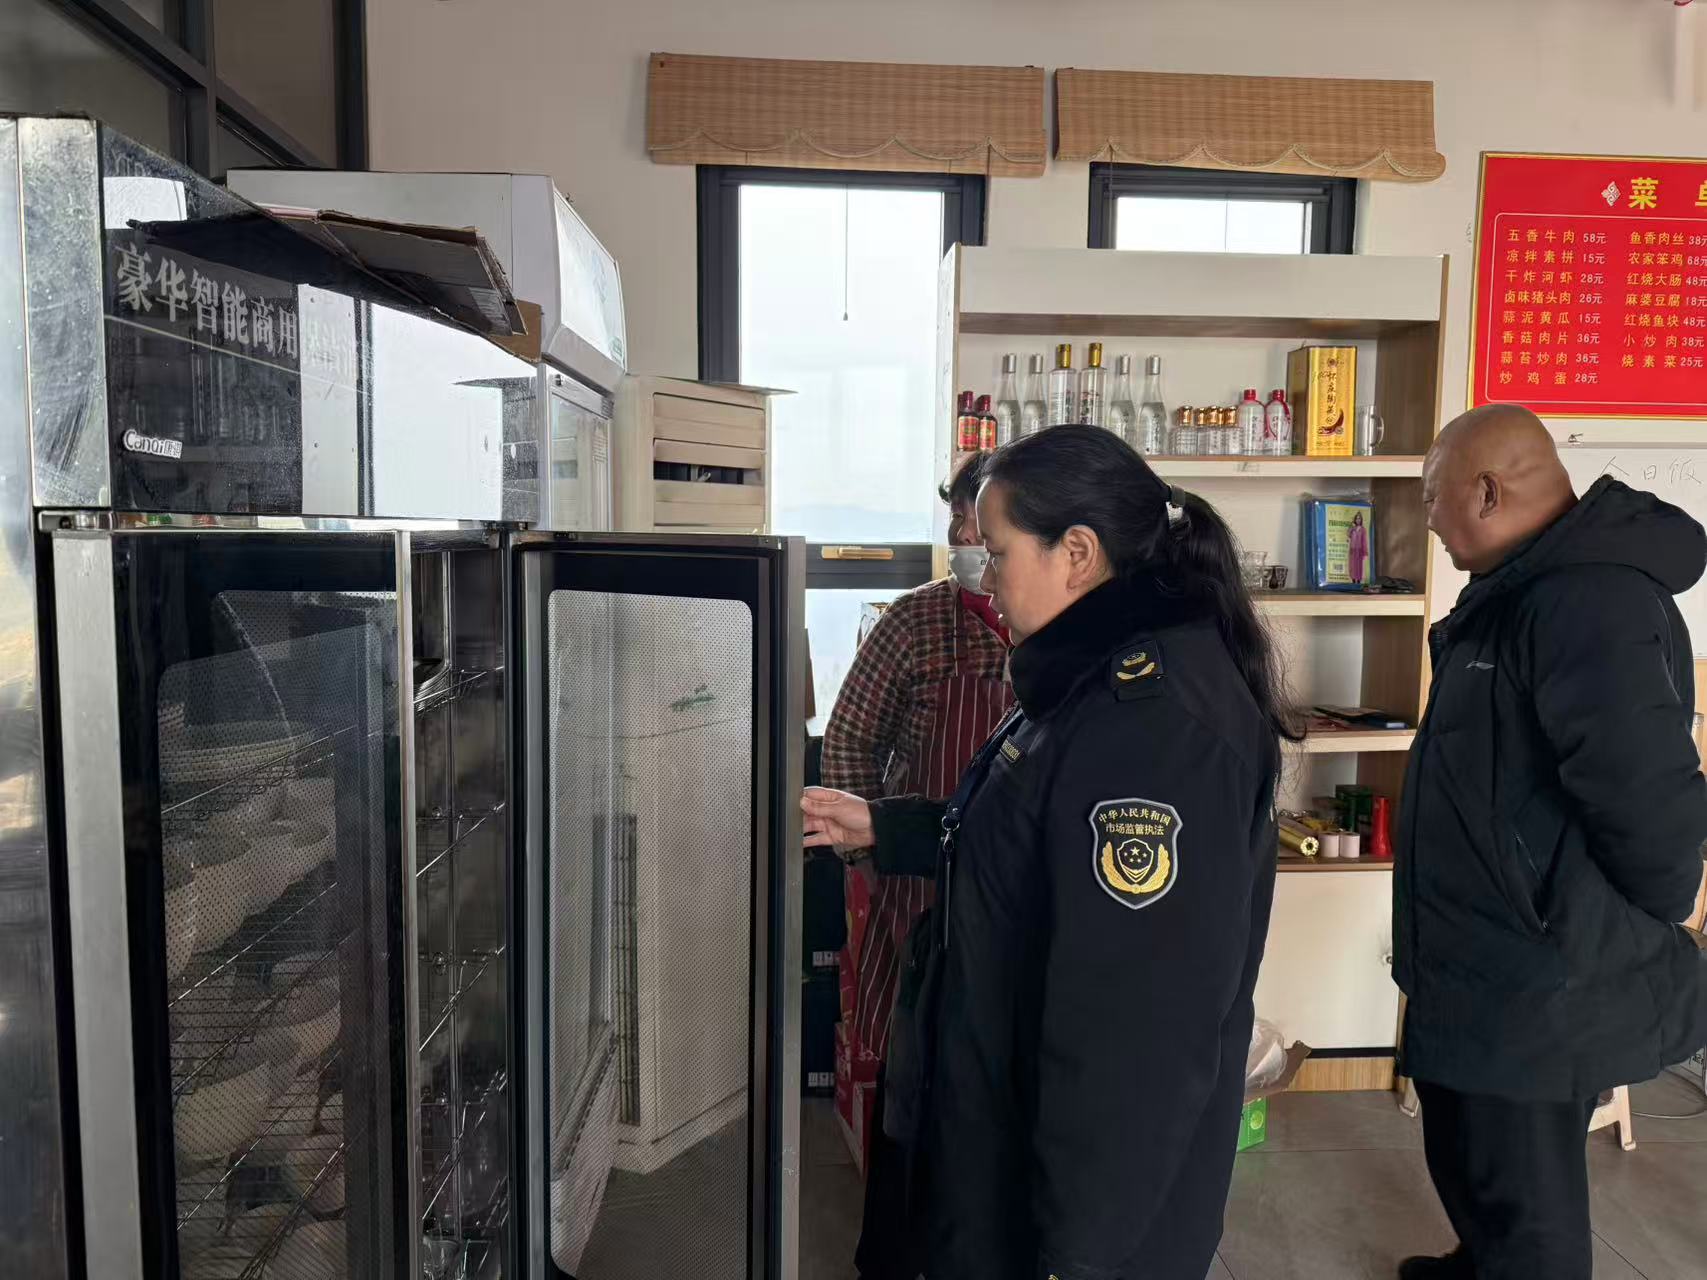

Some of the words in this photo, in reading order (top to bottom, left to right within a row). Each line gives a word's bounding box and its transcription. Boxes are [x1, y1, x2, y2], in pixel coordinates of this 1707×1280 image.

[1507, 229, 1575, 244] 五香牛肉
[1583, 232, 1607, 244] 58元
[1630, 232, 1685, 246] 鱼香肉丝
[1506, 249, 1574, 264] 凉拌素拼
[1583, 253, 1606, 264] 15元
[1628, 252, 1683, 266] 农家笨鸡
[1505, 269, 1573, 284] 干炸河虾
[1580, 273, 1604, 284] 28元
[1627, 273, 1682, 287] 红烧大肠
[1504, 290, 1571, 304] 卤味猪头肉
[1579, 293, 1603, 304] 26元
[1625, 293, 1681, 307] 麻婆豆腐
[1686, 296, 1707, 307] 18元
[1503, 310, 1570, 324] 蒜泥黄瓜
[1579, 313, 1601, 324] 15元
[1624, 314, 1680, 328] 红烧鱼块
[1683, 316, 1706, 327] 48元
[1503, 331, 1568, 345] 香菇肉片
[1577, 333, 1600, 344] 36元
[1623, 334, 1677, 348] 小炒肉
[1681, 336, 1705, 348] 38元
[1501, 351, 1567, 365] 蒜苔炒肉
[1575, 353, 1599, 364] 36元
[1621, 355, 1677, 368] 烧素菜
[1680, 356, 1704, 368] 25元
[1499, 372, 1567, 385] 炒鸡蛋
[1574, 373, 1598, 384] 28元
[1098, 808, 1171, 826] 中华人民共和国
[1105, 823, 1165, 836] 市场监管执法
